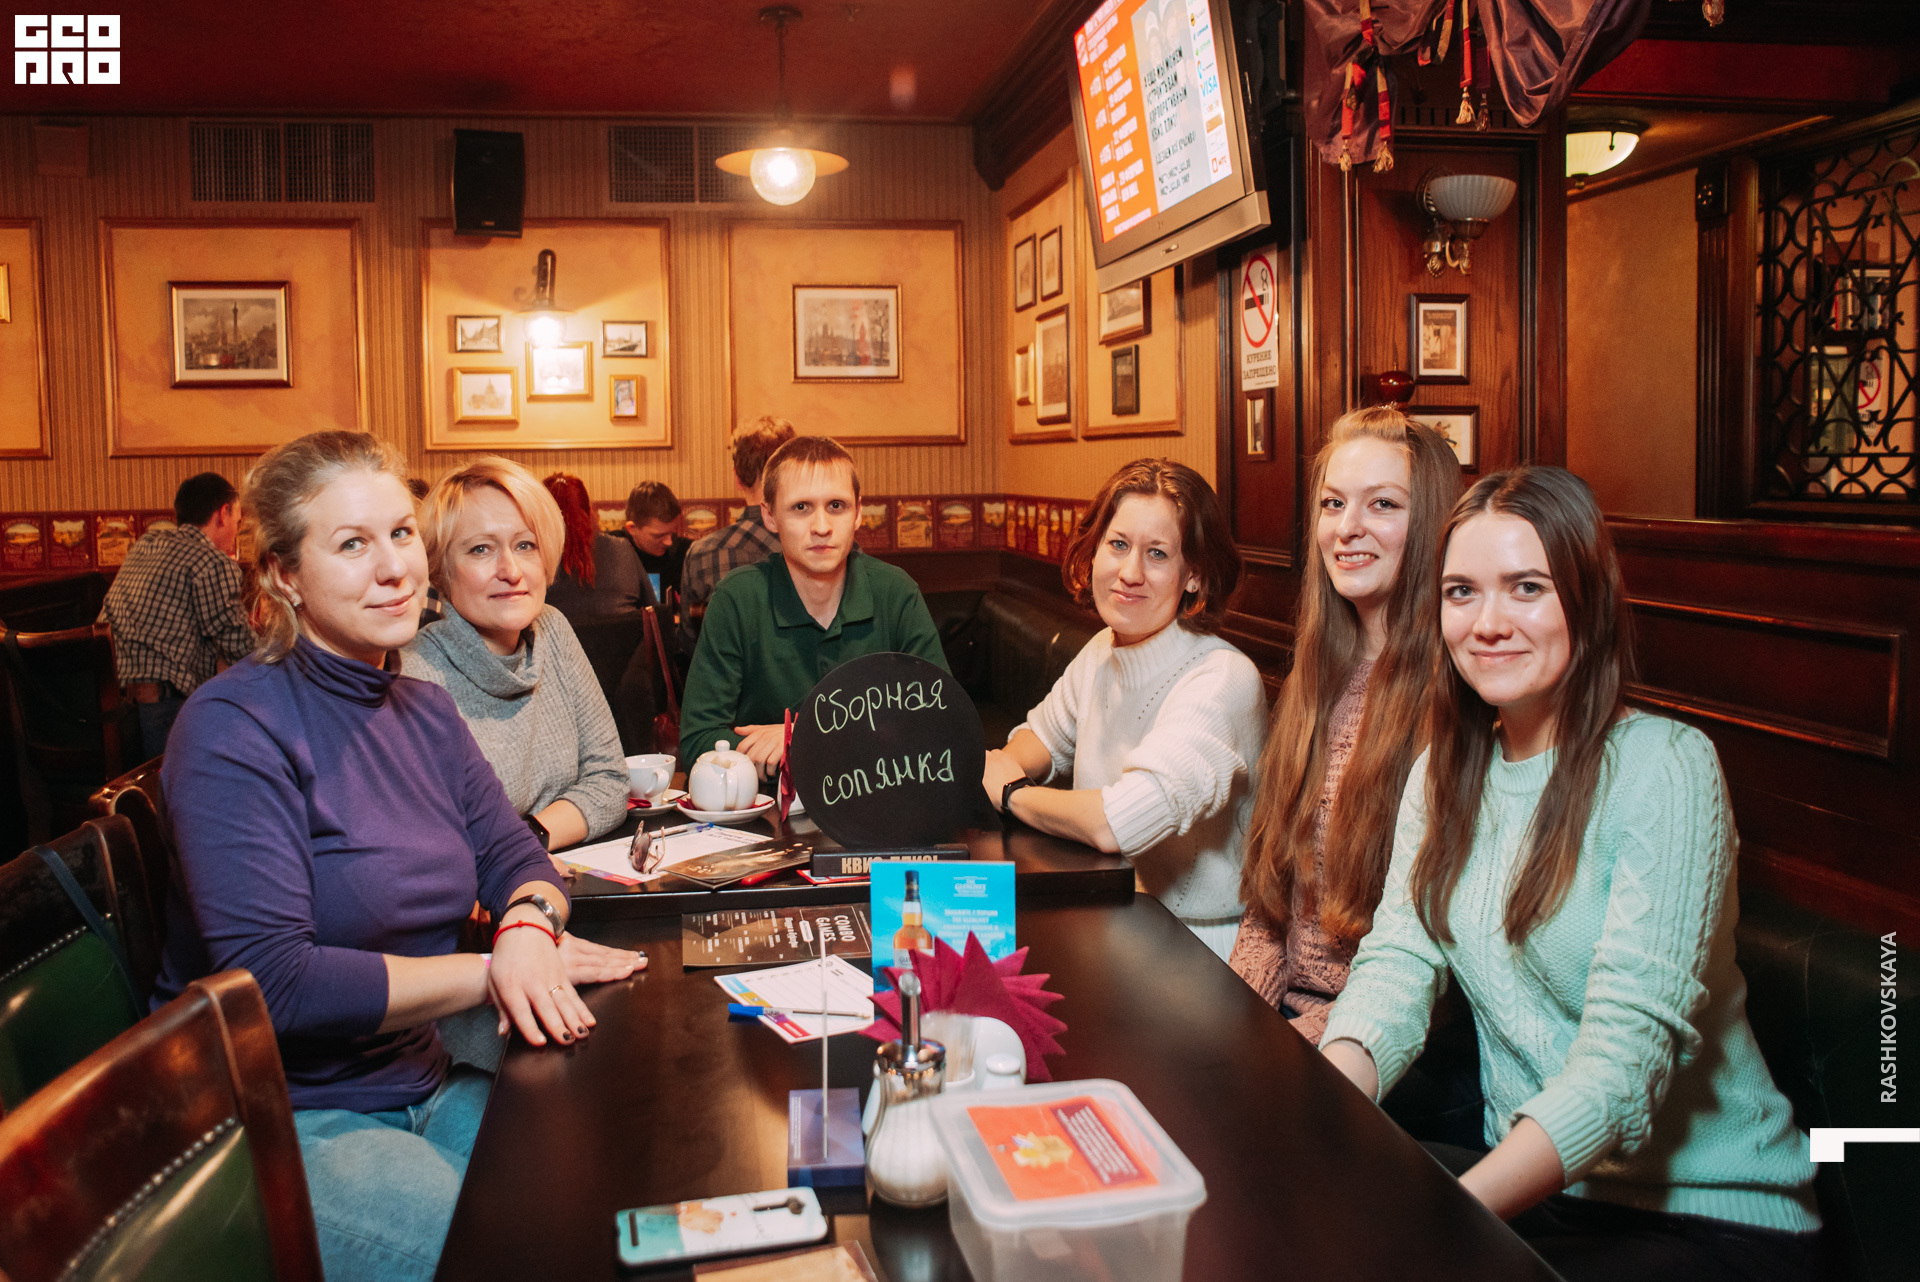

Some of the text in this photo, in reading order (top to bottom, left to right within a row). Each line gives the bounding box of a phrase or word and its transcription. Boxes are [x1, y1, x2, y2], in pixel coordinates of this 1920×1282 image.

[1200, 74, 1218, 98] VISA
[1246, 350, 1271, 364] КУРЕНИЕ
[1243, 365, 1276, 380] ЗАПРЕЩЕНО
[814, 678, 947, 734] Сборная
[815, 917, 836, 943] GAMES
[834, 915, 856, 942] COMBO
